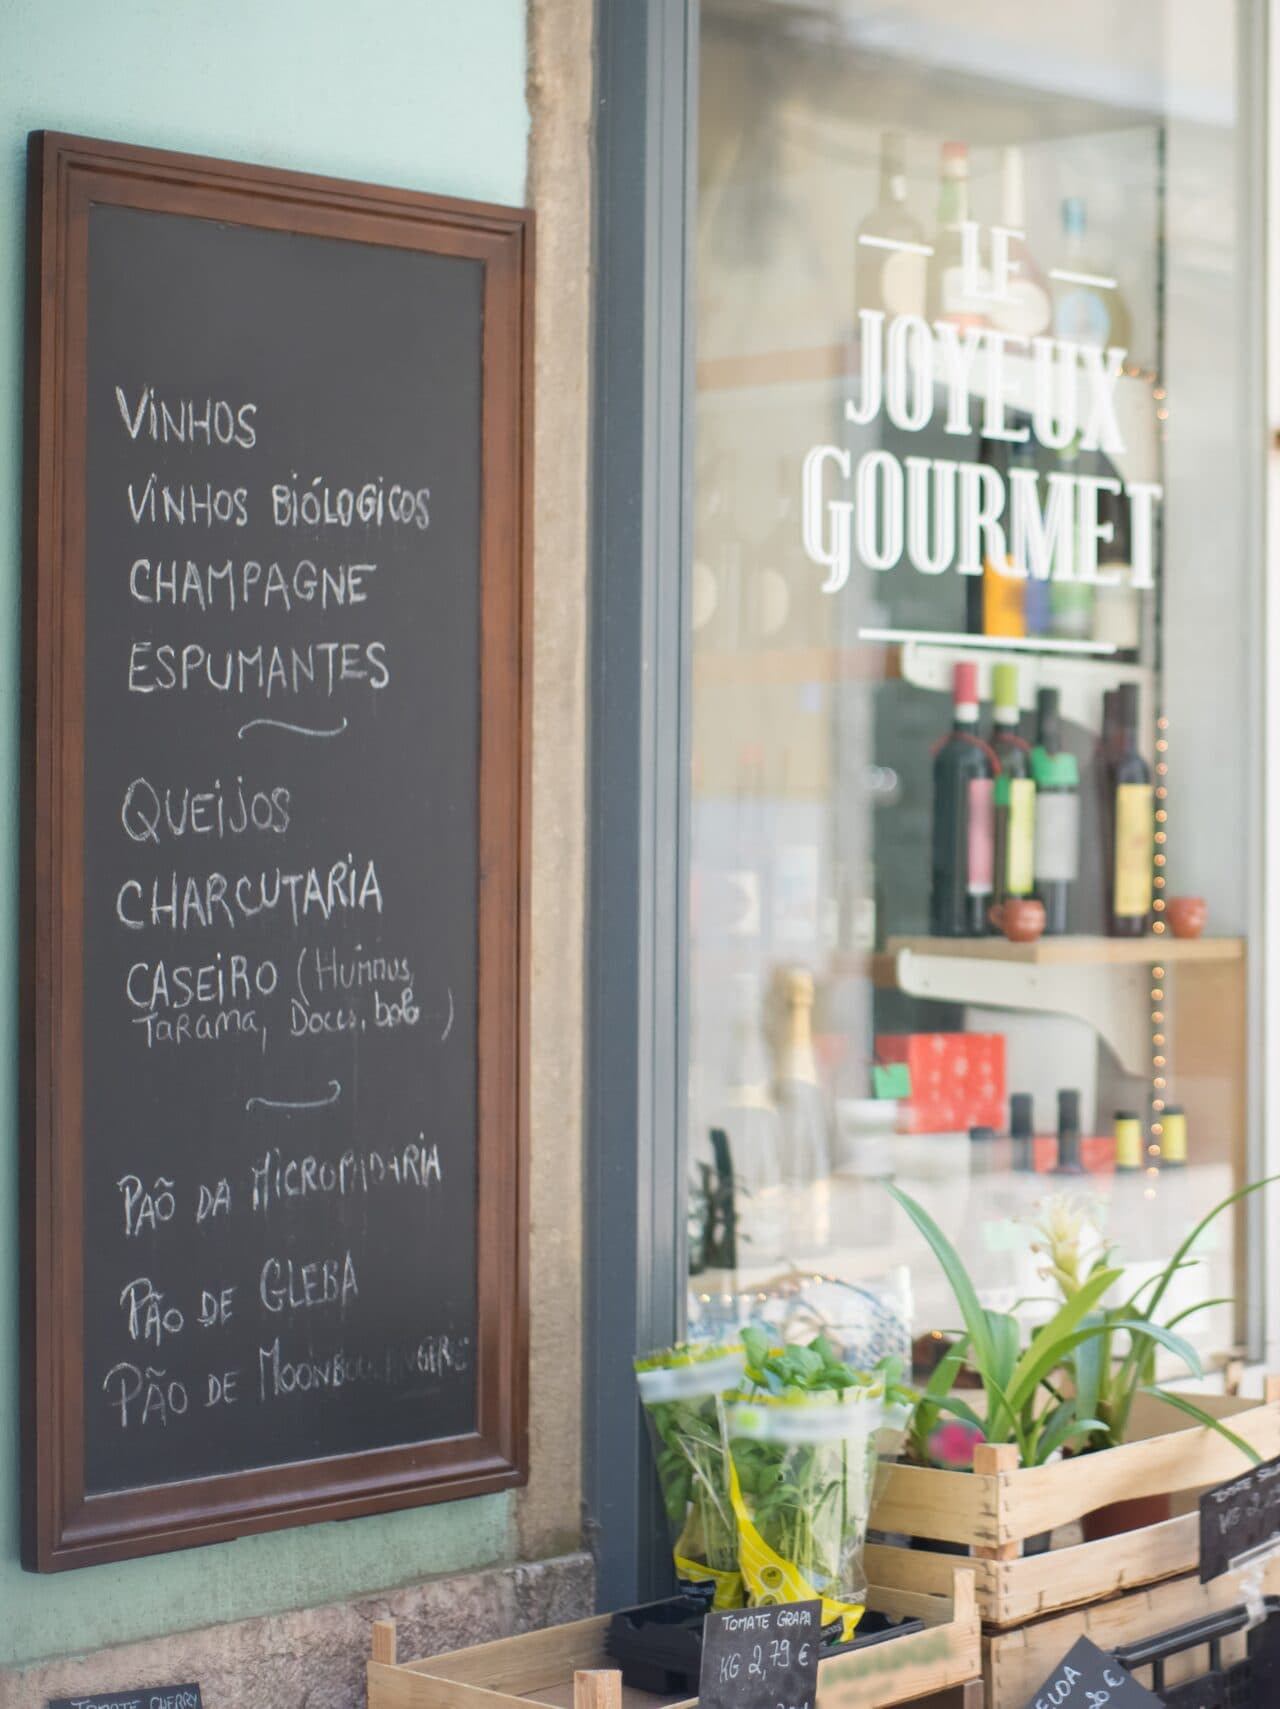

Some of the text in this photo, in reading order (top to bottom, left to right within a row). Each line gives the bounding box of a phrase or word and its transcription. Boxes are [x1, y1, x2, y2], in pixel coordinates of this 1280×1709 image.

[960, 221, 1026, 300] LE
[846, 308, 1127, 454] JOYEUX
[802, 444, 1163, 594] GOURMET
[130, 558, 377, 612] CHAMPAGNE
[128, 641, 390, 699] ESPUMANTES
[196, 1176, 231, 1224] DA
[197, 1287, 239, 1328] DE
[259, 1250, 359, 1313] GLEBA
[103, 1362, 188, 1427] PÃO
[204, 1372, 241, 1408] DE
[721, 1610, 811, 1632] TOMATE GRAPA
[720, 1653, 741, 1683] KG
[798, 1643, 810, 1666] €
